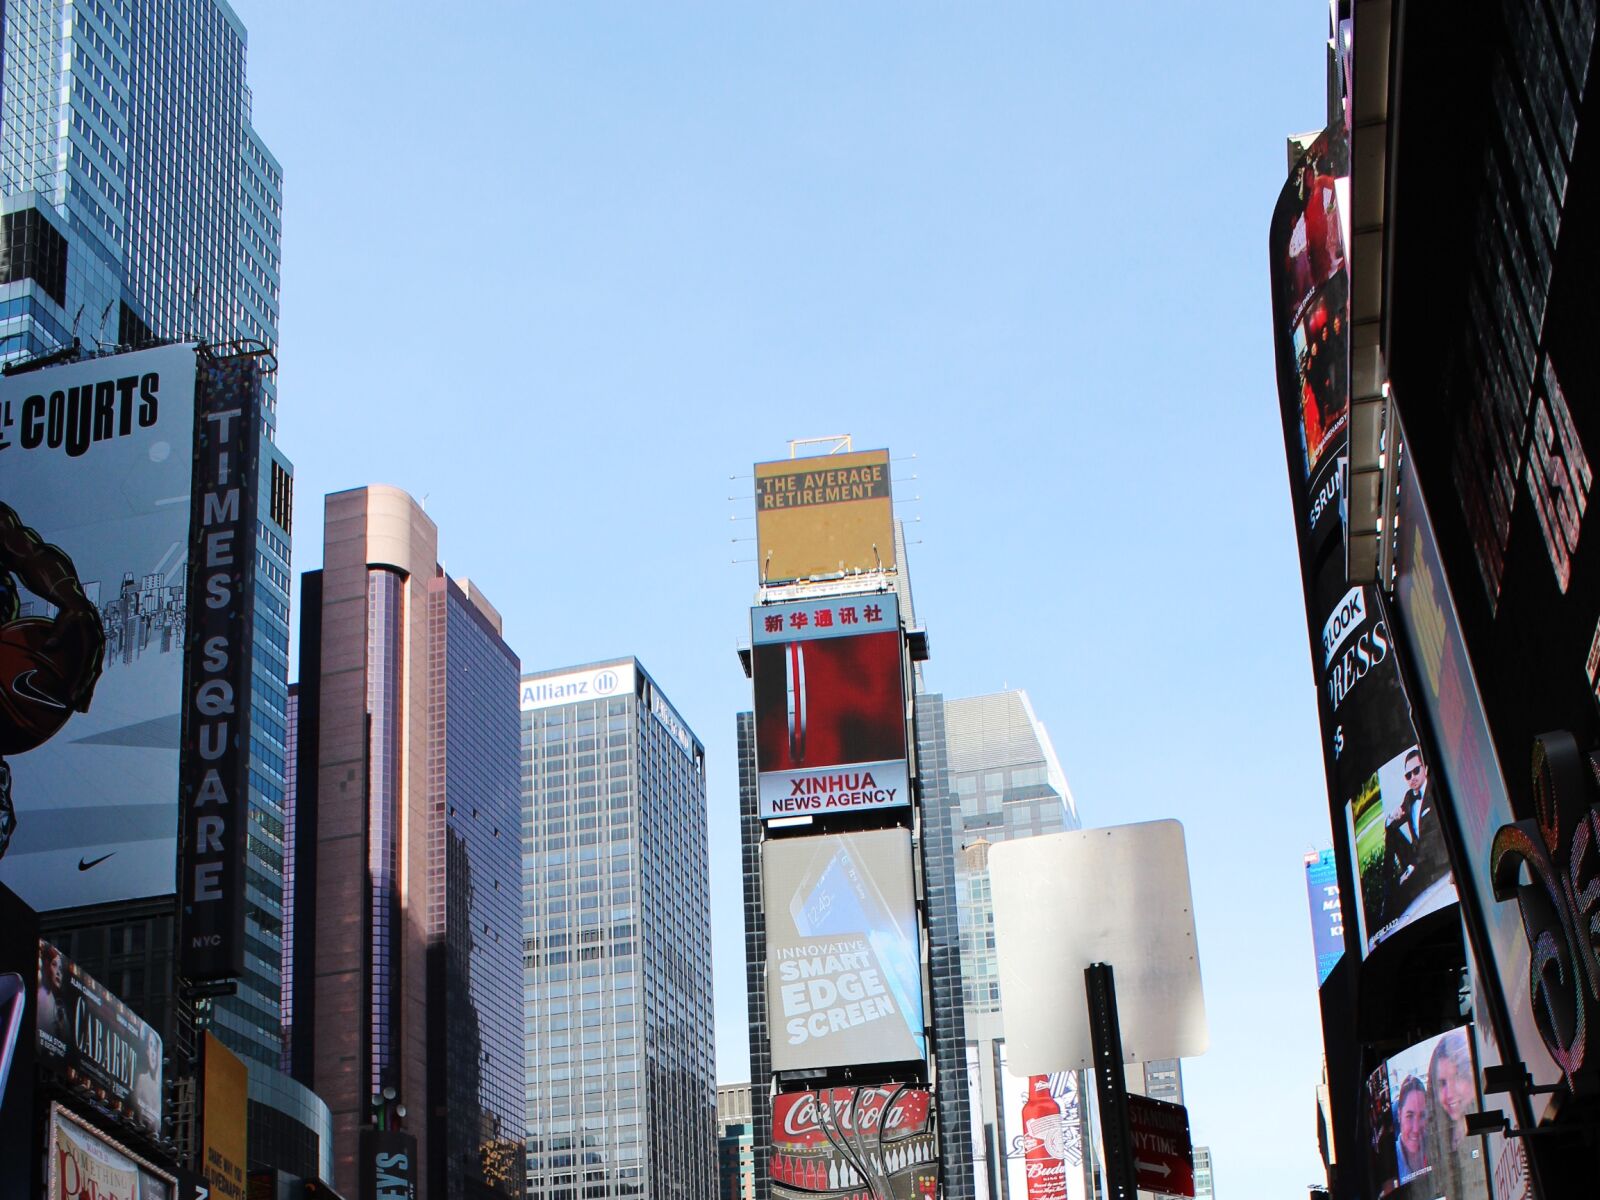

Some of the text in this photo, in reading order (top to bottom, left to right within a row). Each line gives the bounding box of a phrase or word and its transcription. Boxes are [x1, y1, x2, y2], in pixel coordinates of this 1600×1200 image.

[20, 372, 160, 457] COURTS
[764, 467, 882, 493] THE AVERAGE
[764, 483, 874, 508] RETIREMENT
[764, 604, 883, 633] 新华通讯社
[194, 408, 242, 901] TIMES SQUARE
[522, 680, 589, 704] Allianz
[790, 772, 877, 796] XINHUA
[773, 789, 897, 812] NEWS AGENCY
[193, 935, 221, 948] NYC
[777, 940, 865, 960] INNOVATIVE
[779, 951, 870, 981] SMART
[780, 969, 887, 1018] EDGE
[786, 995, 896, 1046] SCREEN
[75, 996, 137, 1091] CABARET
[1130, 1131, 1178, 1157] NYTIME
